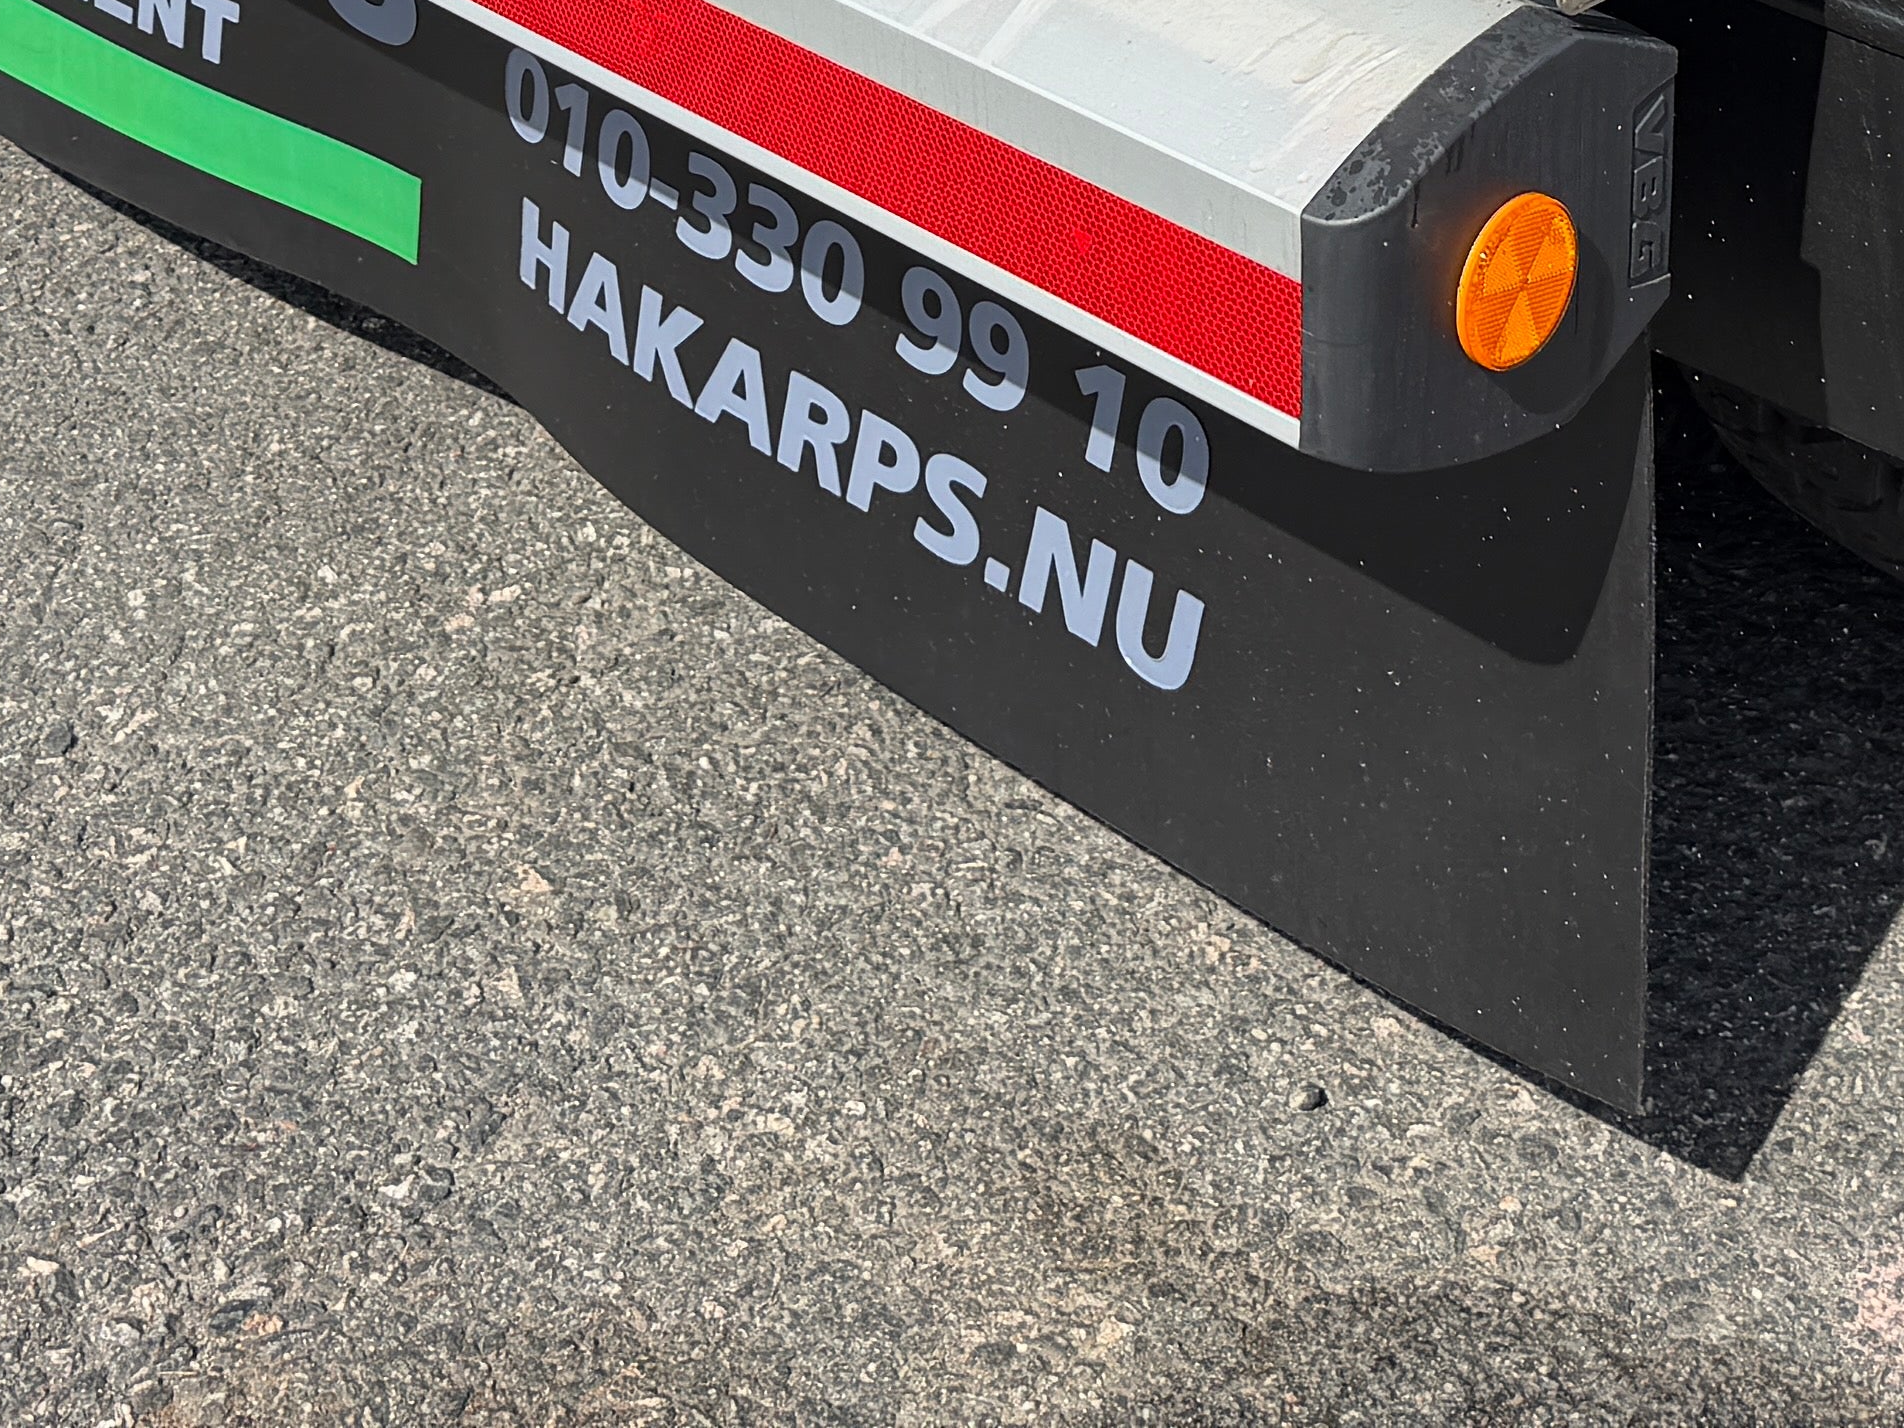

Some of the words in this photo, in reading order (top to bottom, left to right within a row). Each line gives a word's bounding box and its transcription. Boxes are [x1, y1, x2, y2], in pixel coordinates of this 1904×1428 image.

[504, 47, 865, 327] 010-330
[894, 266, 1029, 413] 99
[1074, 363, 1210, 514] 10
[1632, 94, 1668, 282] VBG
[519, 195, 1205, 690] HAKARPS.NU
